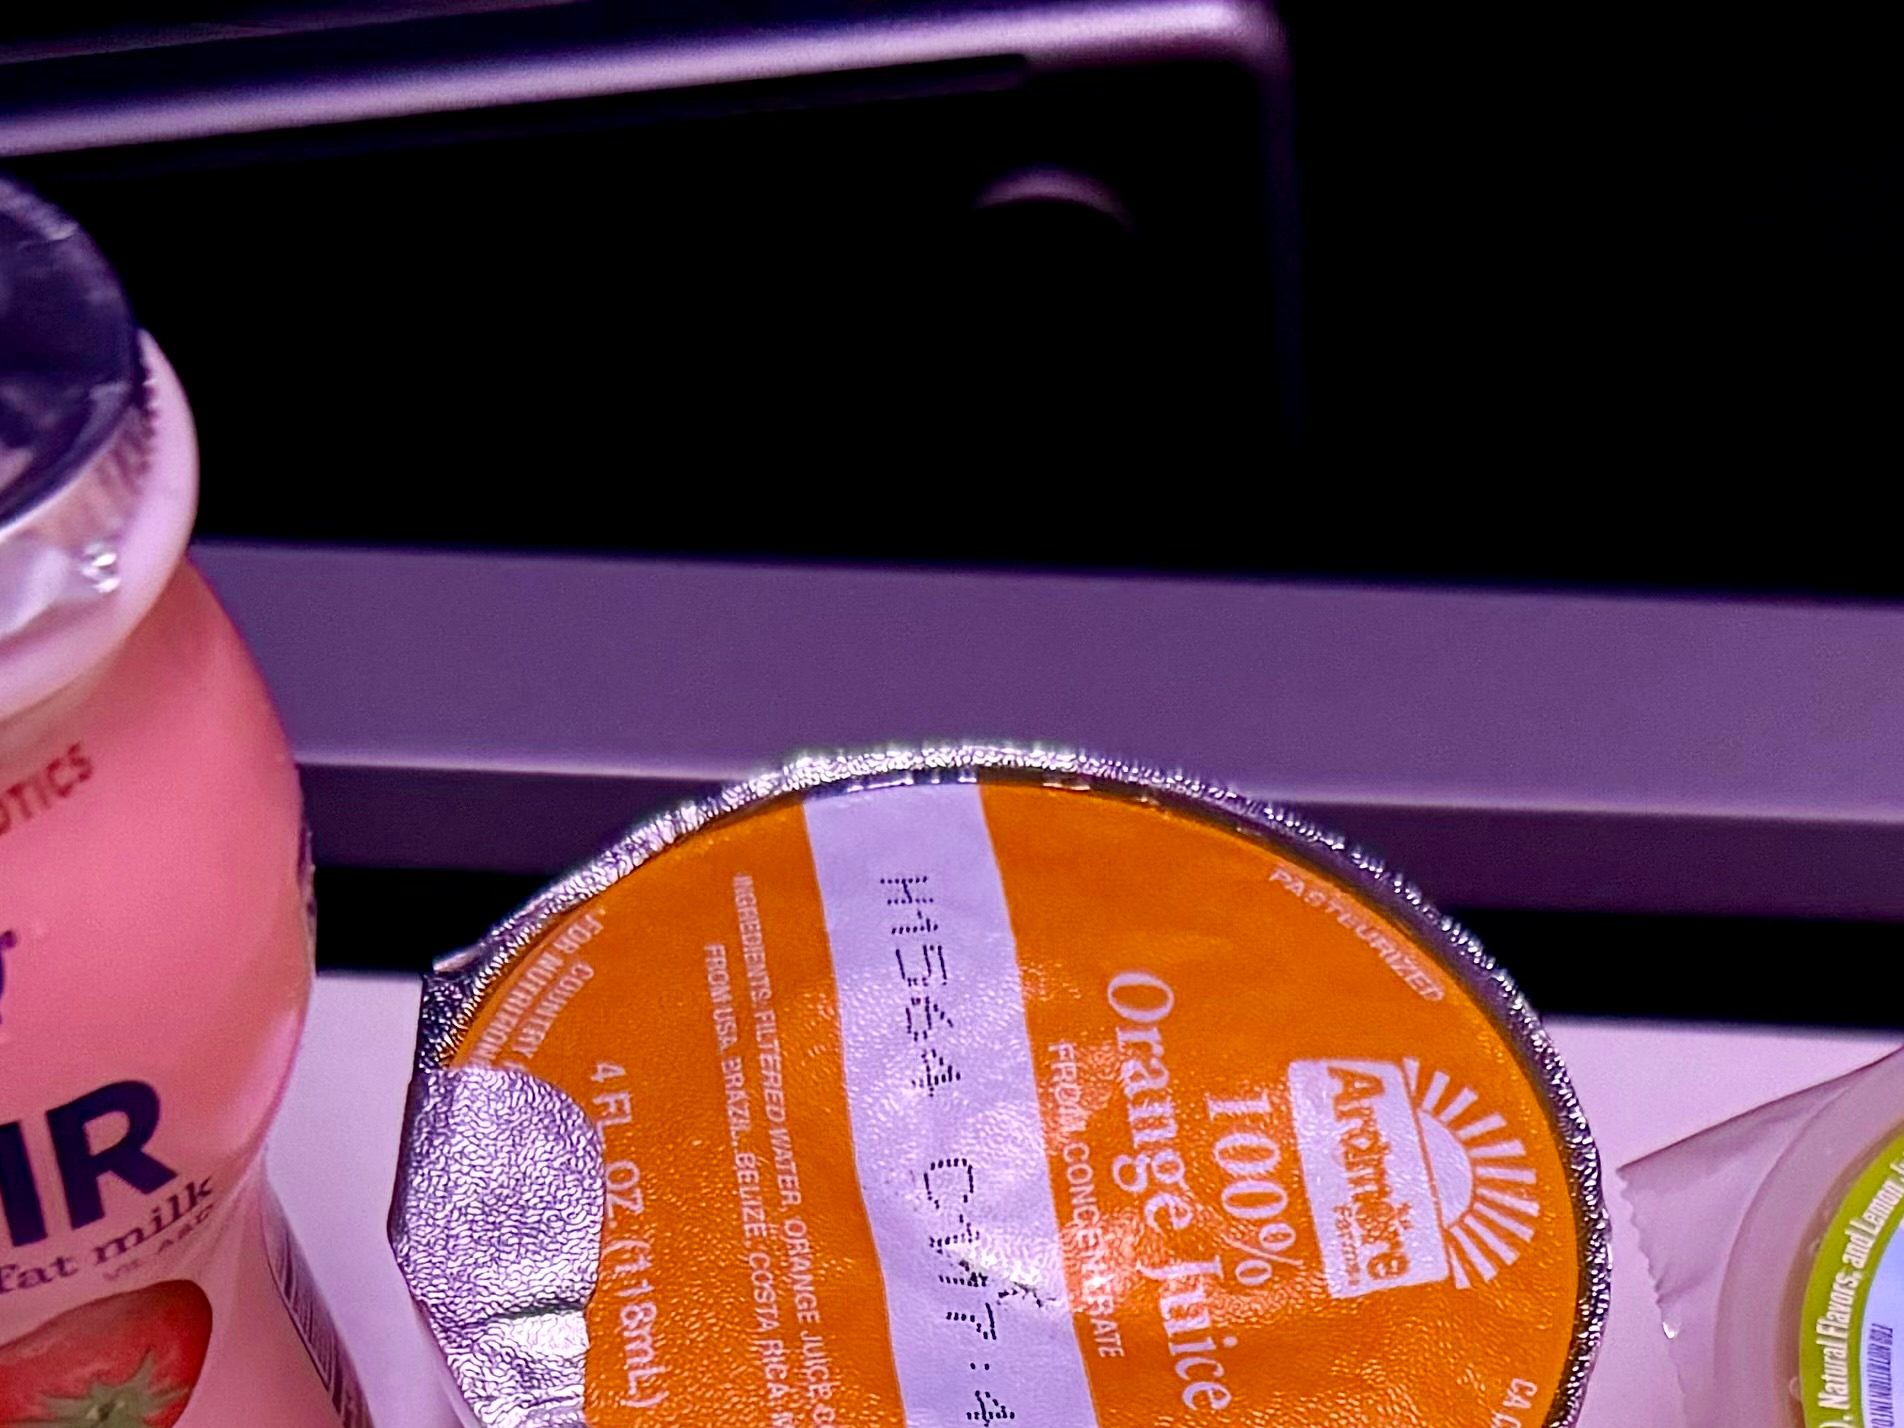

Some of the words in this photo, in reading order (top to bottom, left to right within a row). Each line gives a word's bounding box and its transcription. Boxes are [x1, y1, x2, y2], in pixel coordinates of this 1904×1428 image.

[552, 913, 604, 956] FOR
[1268, 868, 1444, 1001] PASTEURIZED
[470, 951, 564, 1062] NUTRITION
[511, 961, 596, 1060] COUNTRY
[591, 1061, 625, 1080] 4
[753, 1010, 785, 1122] FILTERED
[1048, 1042, 1086, 1135] FROM
[1107, 972, 1189, 1230] Orange
[703, 944, 732, 1003] FROM
[746, 1251, 779, 1330] COSTA
[768, 1128, 801, 1212] WATER,
[1327, 1065, 1414, 1281] Ardmore
[96, 1175, 214, 1269] milk
[602, 1158, 644, 1228] OZ.
[1205, 1089, 1301, 1286] 100%
[783, 1218, 819, 1324] ORANGE
[1062, 1141, 1123, 1357] CONCENTRATE
[1333, 1205, 1362, 1274] Farms
[1841, 1227, 1876, 1269] and
[604, 1240, 665, 1410] (118mL)
[1135, 1256, 1237, 1411] Juice
[1815, 1270, 1862, 1340] Flavors,
[799, 1331, 831, 1402] JUICE
[1502, 1378, 1537, 1408] CA
[1816, 1337, 1850, 1410] Natural
